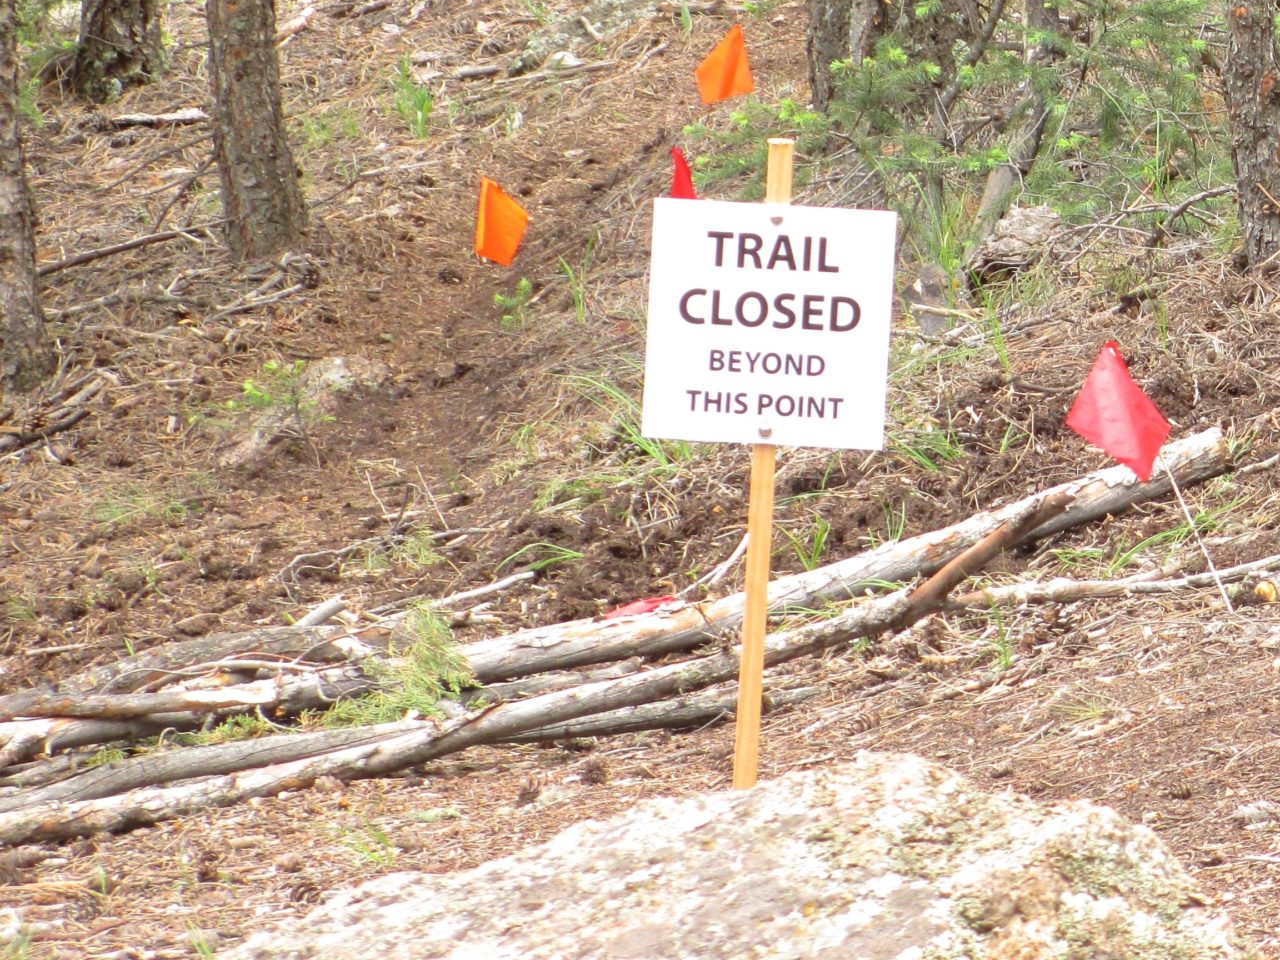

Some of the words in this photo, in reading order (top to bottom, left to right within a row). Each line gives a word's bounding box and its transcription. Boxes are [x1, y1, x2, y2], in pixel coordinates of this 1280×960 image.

[707, 231, 839, 273] TRAIL
[679, 288, 861, 332] CLOSED
[709, 350, 825, 377] BEYOND
[687, 390, 748, 414] THIS
[758, 394, 845, 419] POINT
